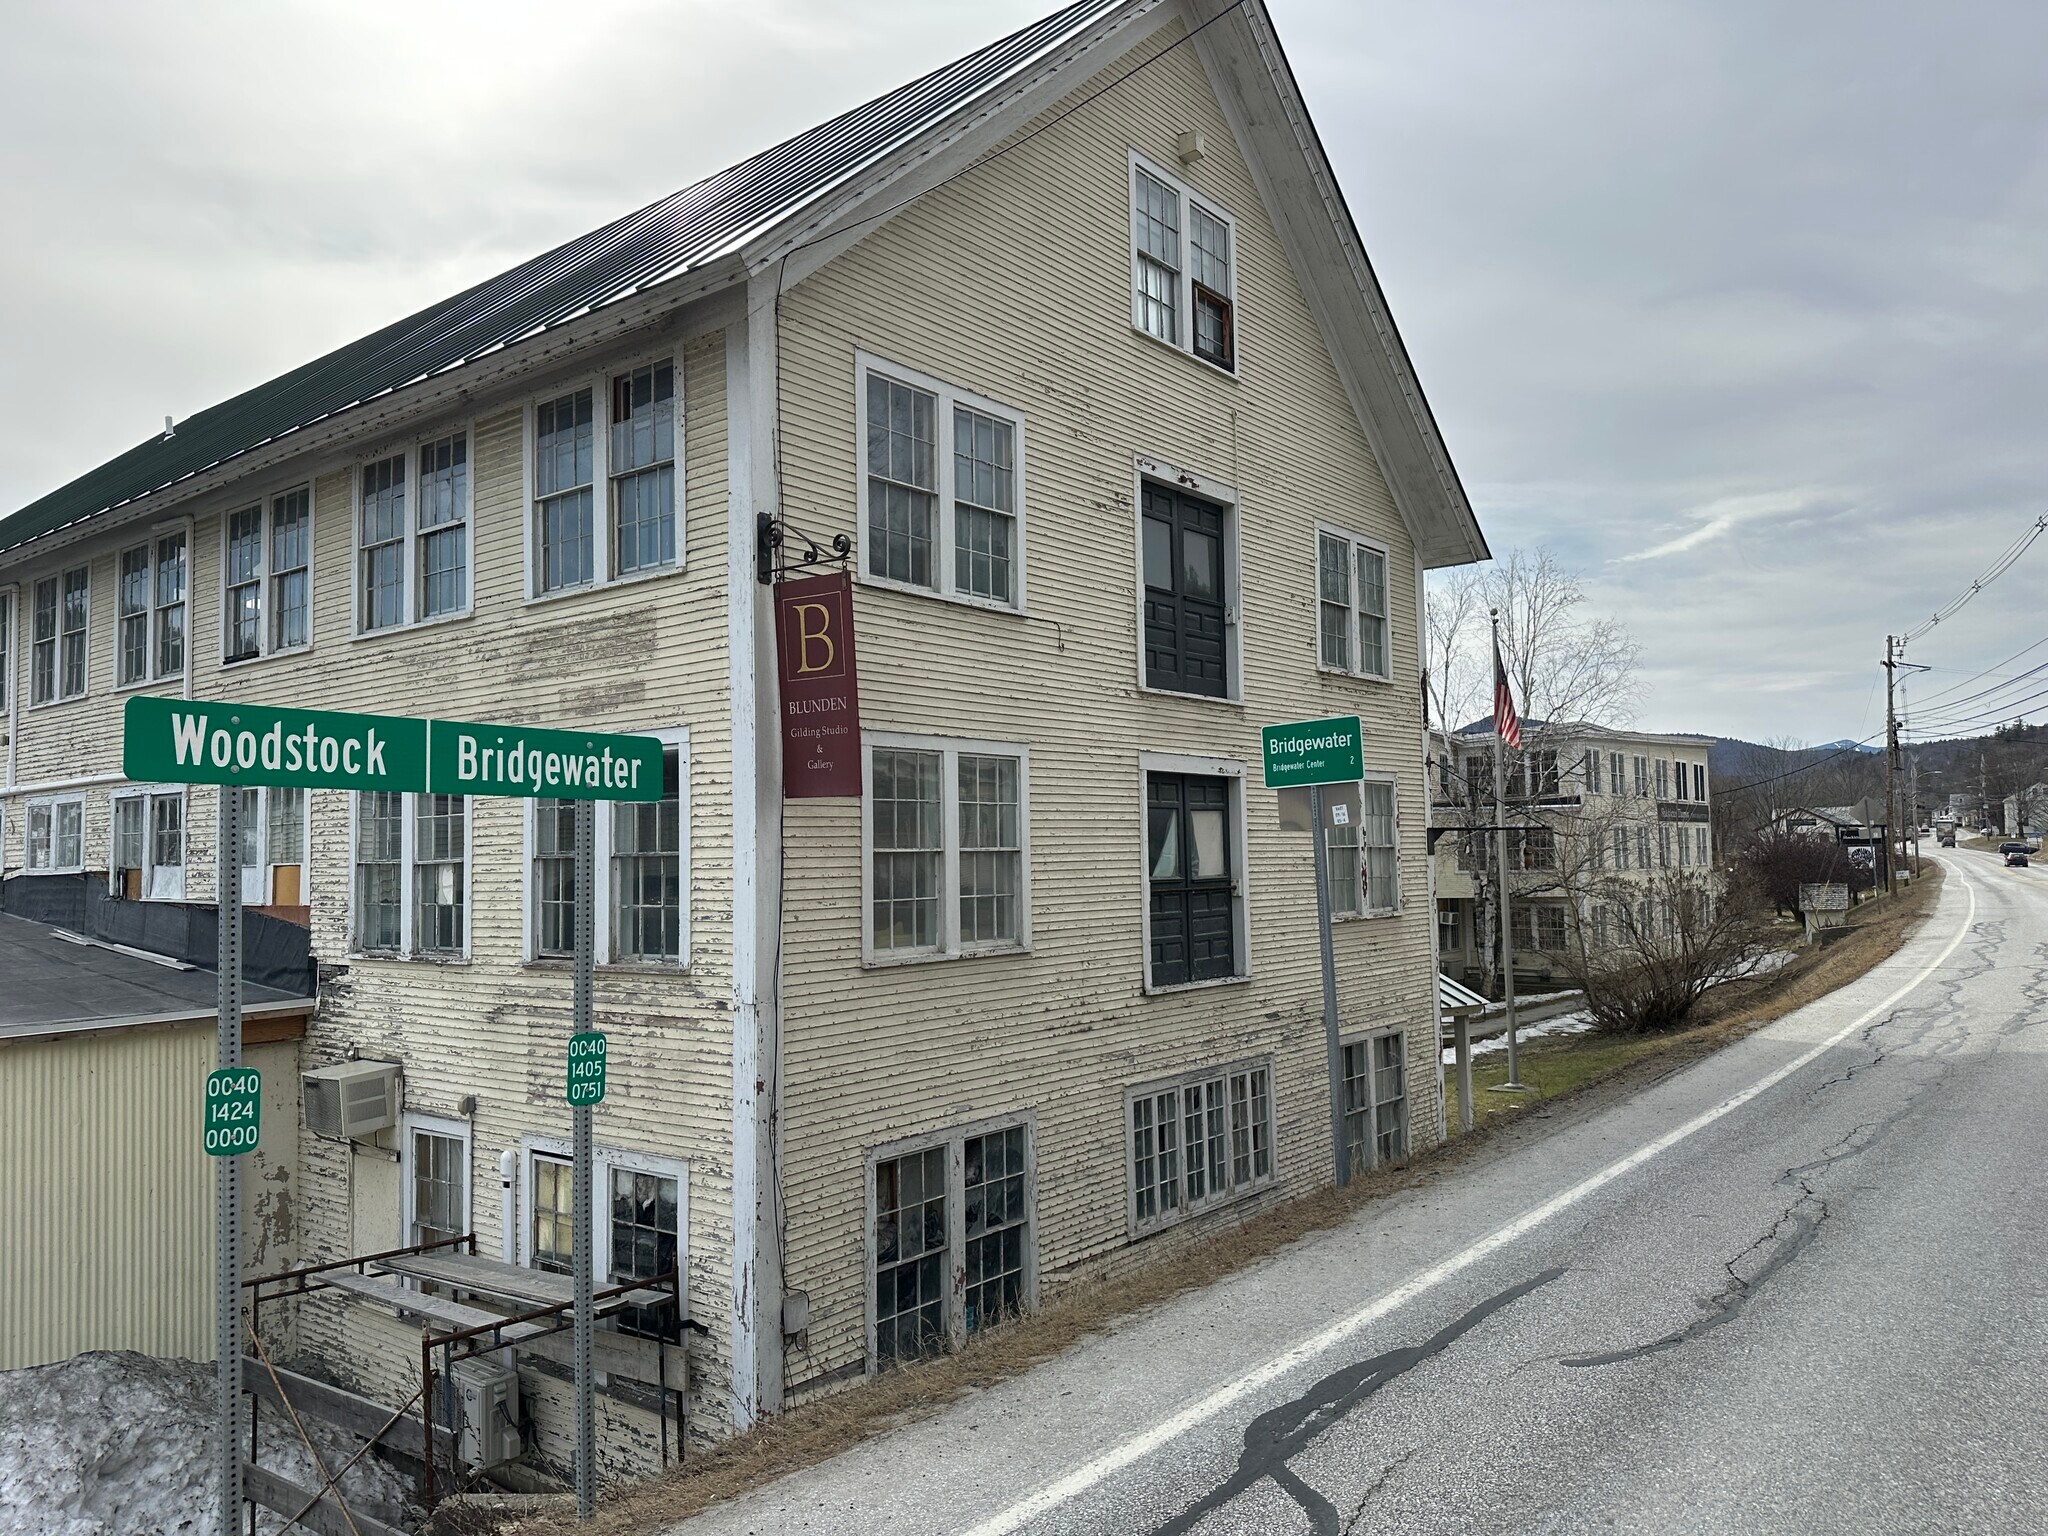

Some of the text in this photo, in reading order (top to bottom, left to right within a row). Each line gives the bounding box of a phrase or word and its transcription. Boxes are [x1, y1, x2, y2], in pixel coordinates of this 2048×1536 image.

[793, 603, 834, 674] B
[789, 697, 847, 715] BLUNDEN
[790, 725, 849, 738] Gilding Studio
[171, 713, 387, 775] Woodstock
[816, 744, 824, 753] &
[1269, 732, 1353, 756] Bridgewater
[457, 735, 642, 793] Bridgewater
[807, 759, 834, 771] Gallery
[1272, 755, 1355, 773] Bridgewater Center 2
[572, 1060, 602, 1078] 1405
[572, 1081, 601, 1100] 0751
[212, 1100, 254, 1123] 1424
[206, 1125, 258, 1149] 0000
